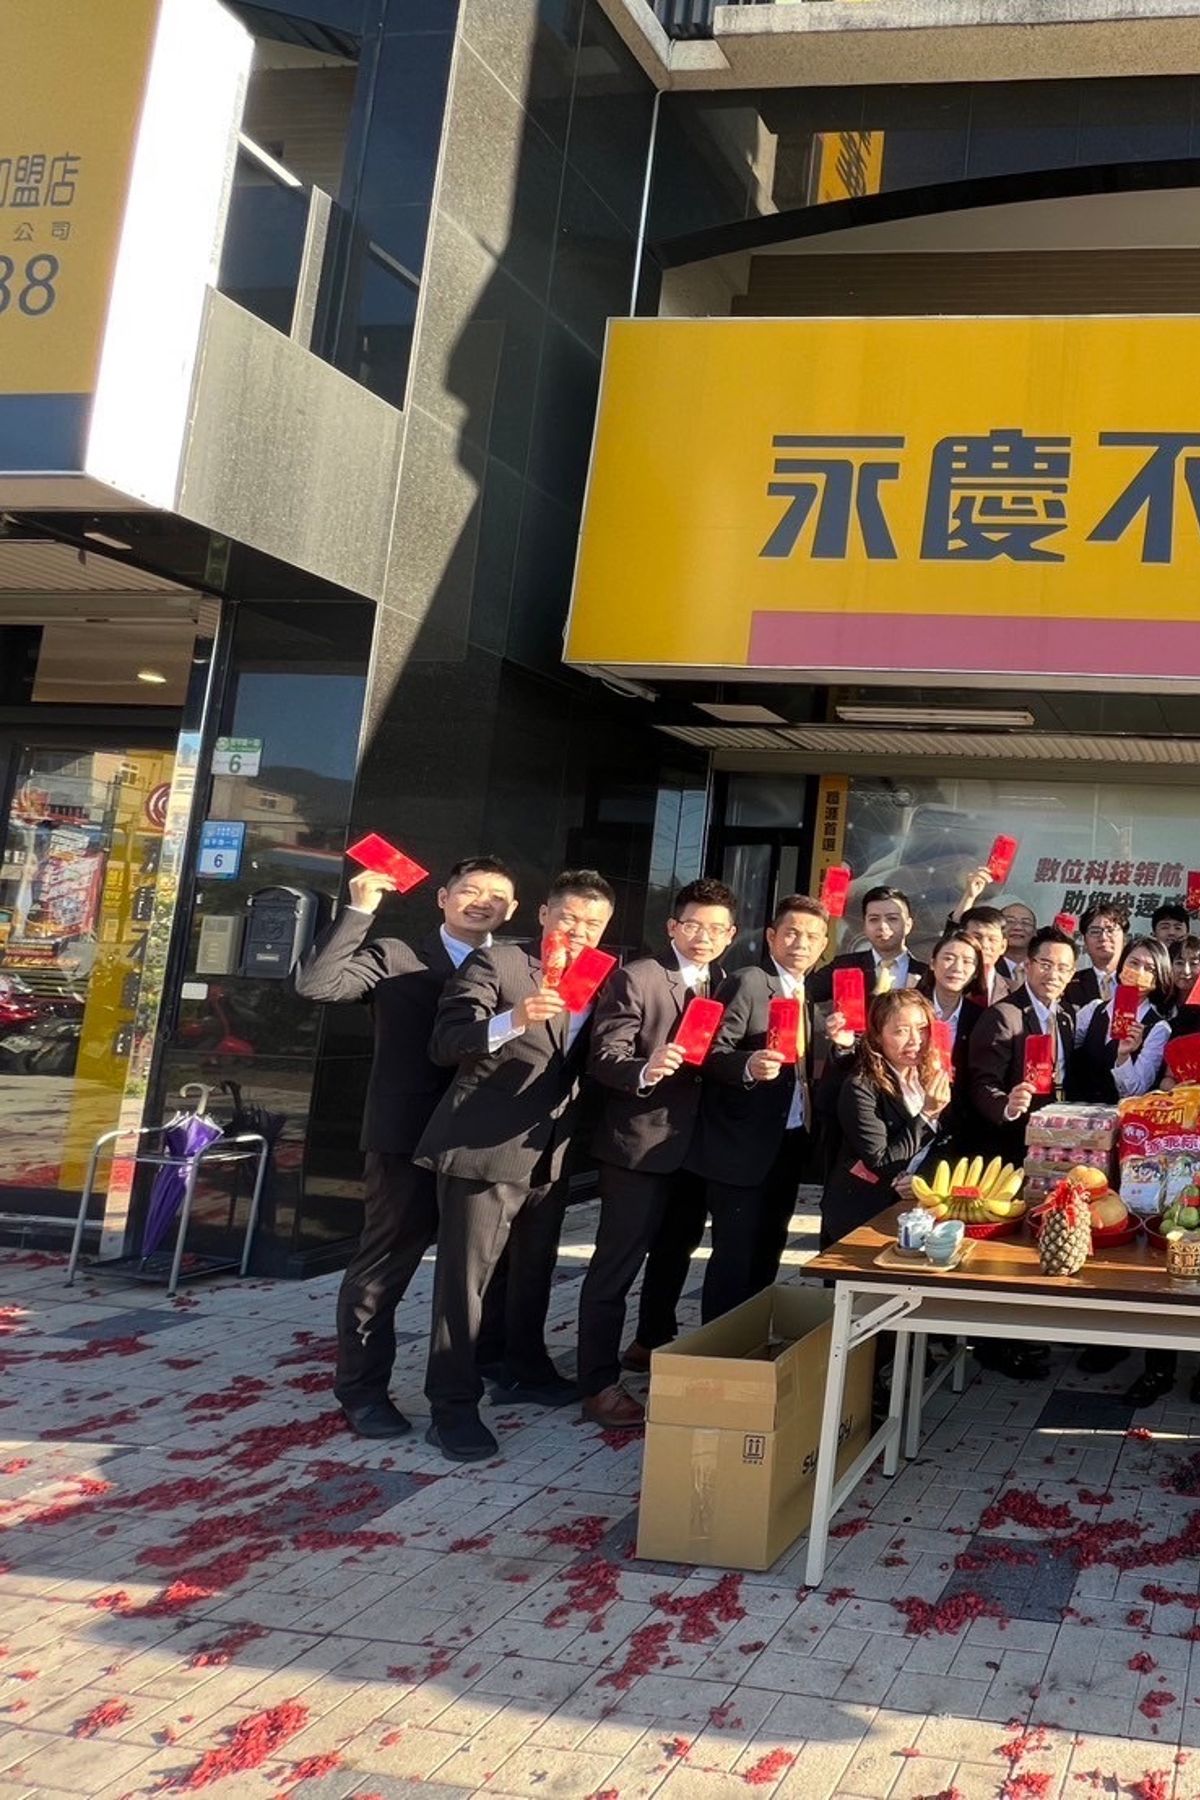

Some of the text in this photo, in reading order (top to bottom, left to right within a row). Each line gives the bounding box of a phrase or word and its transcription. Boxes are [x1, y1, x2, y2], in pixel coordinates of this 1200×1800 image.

[13, 221, 71, 241] 公司
[228, 753, 242, 774] 6
[213, 853, 224, 869] 6
[1033, 857, 1186, 888] 數位科技領航
